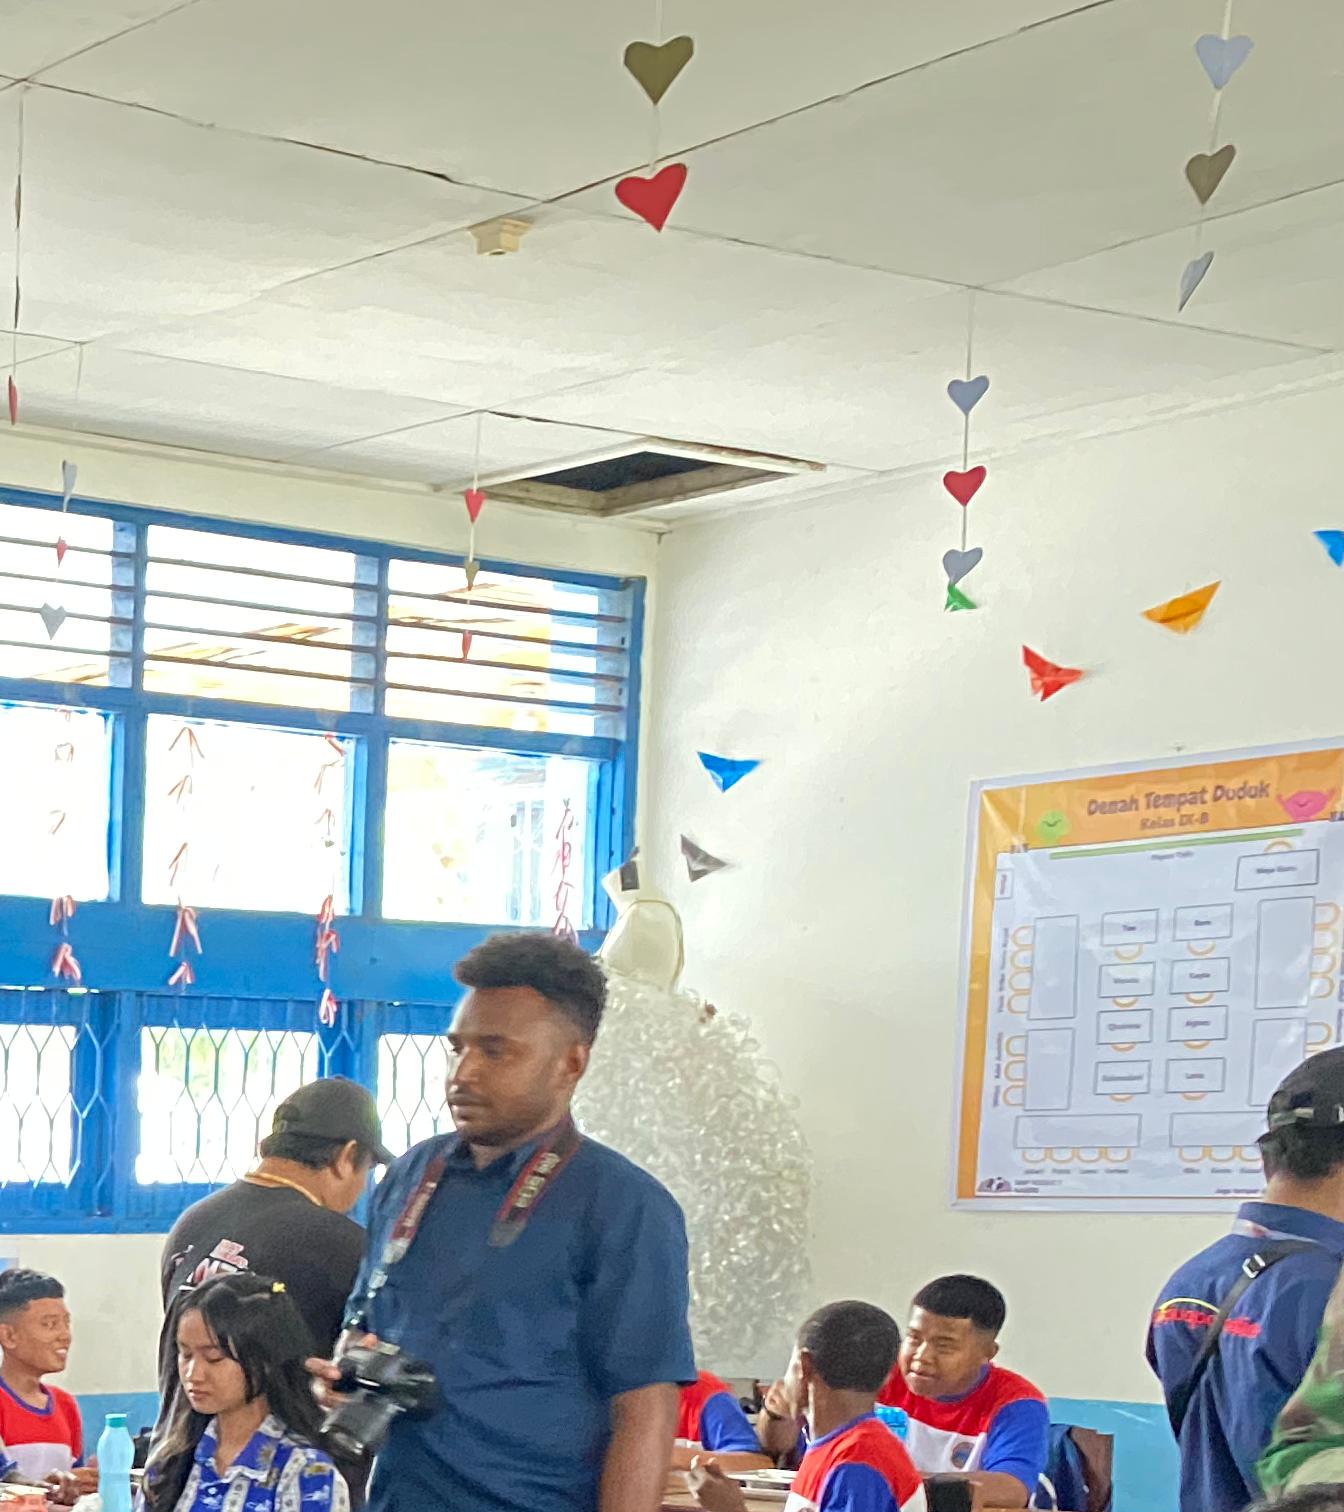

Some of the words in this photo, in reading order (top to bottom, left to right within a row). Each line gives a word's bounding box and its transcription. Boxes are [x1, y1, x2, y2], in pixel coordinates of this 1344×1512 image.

[1087, 794, 1140, 816] Denah
[1144, 785, 1209, 812] Tempat
[1213, 780, 1271, 803] Duduk
